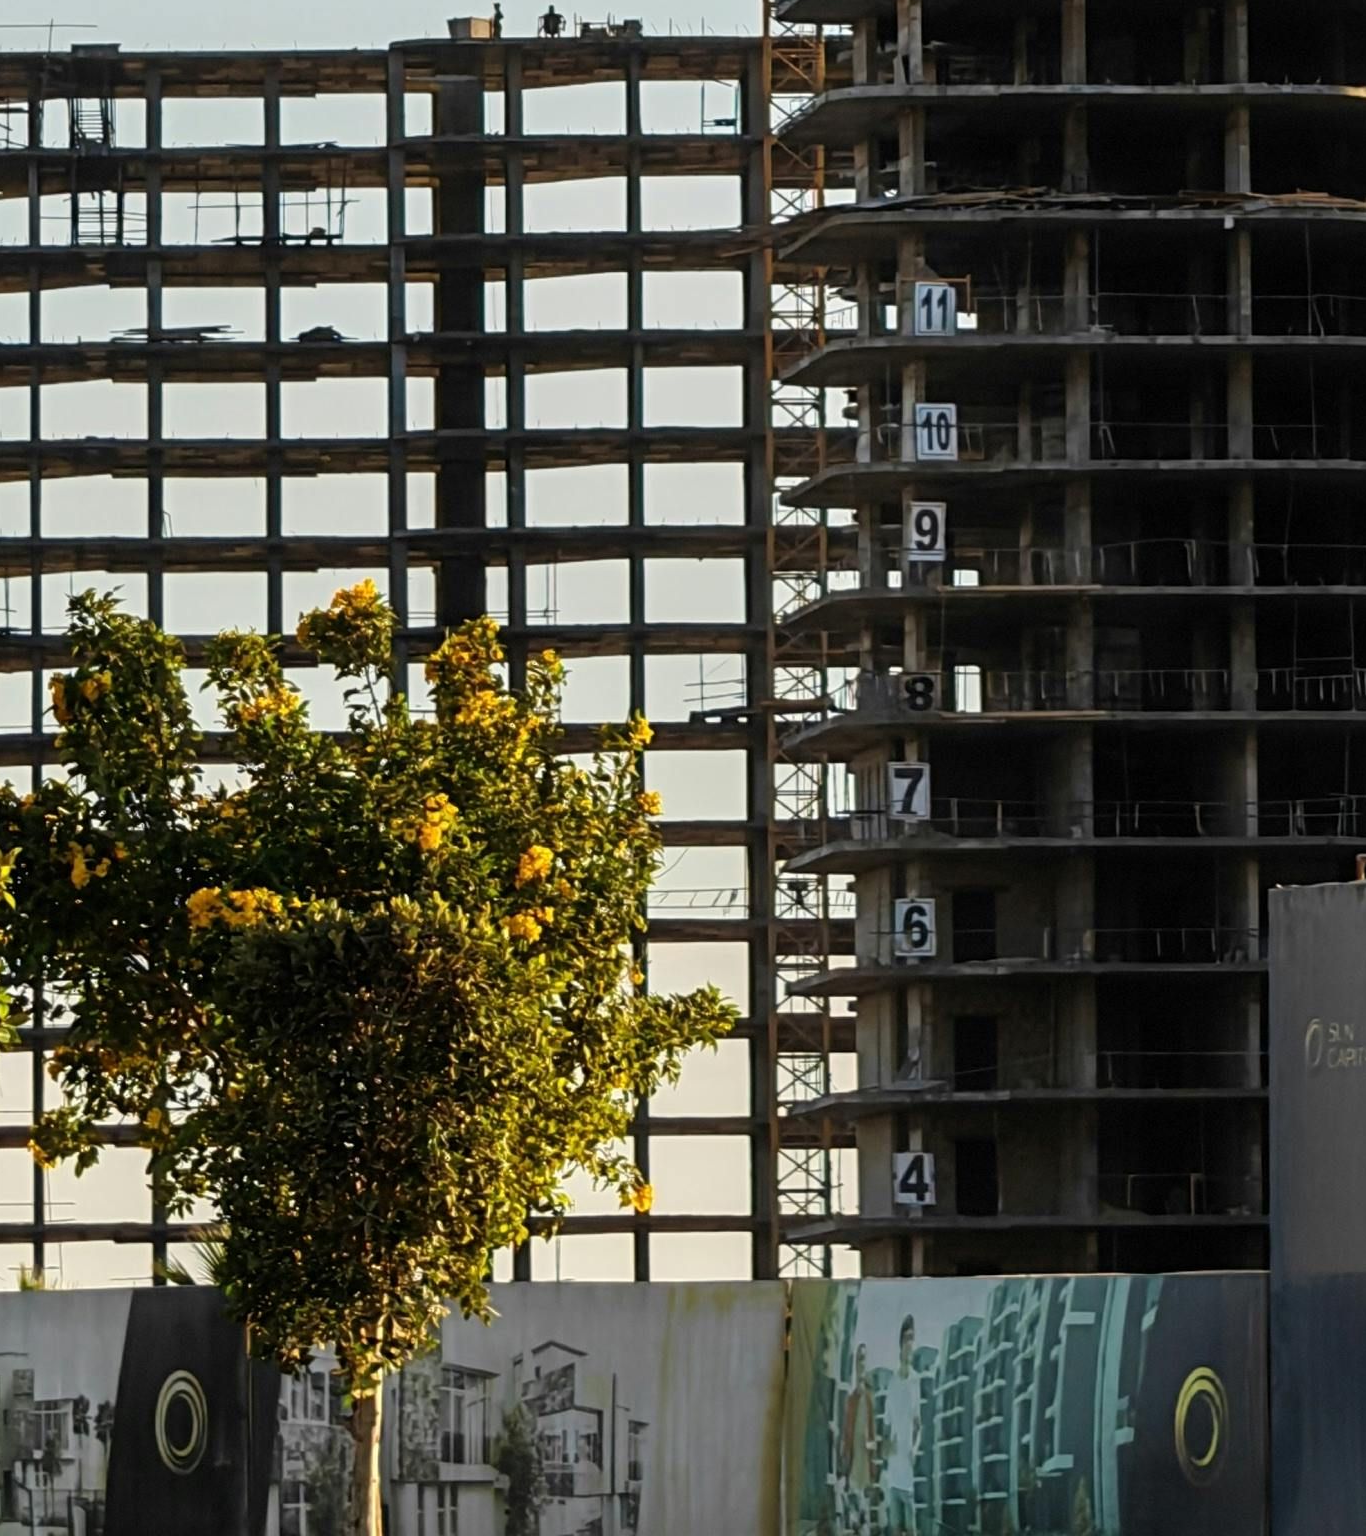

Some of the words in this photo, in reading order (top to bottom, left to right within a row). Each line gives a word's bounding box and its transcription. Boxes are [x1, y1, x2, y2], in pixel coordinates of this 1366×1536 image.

[921, 288, 948, 331] 11
[922, 411, 950, 451] 10
[914, 509, 939, 551] 9
[904, 676, 934, 711] 8
[893, 768, 924, 815] 7
[903, 904, 928, 949] 6
[899, 1154, 929, 1201] 4
